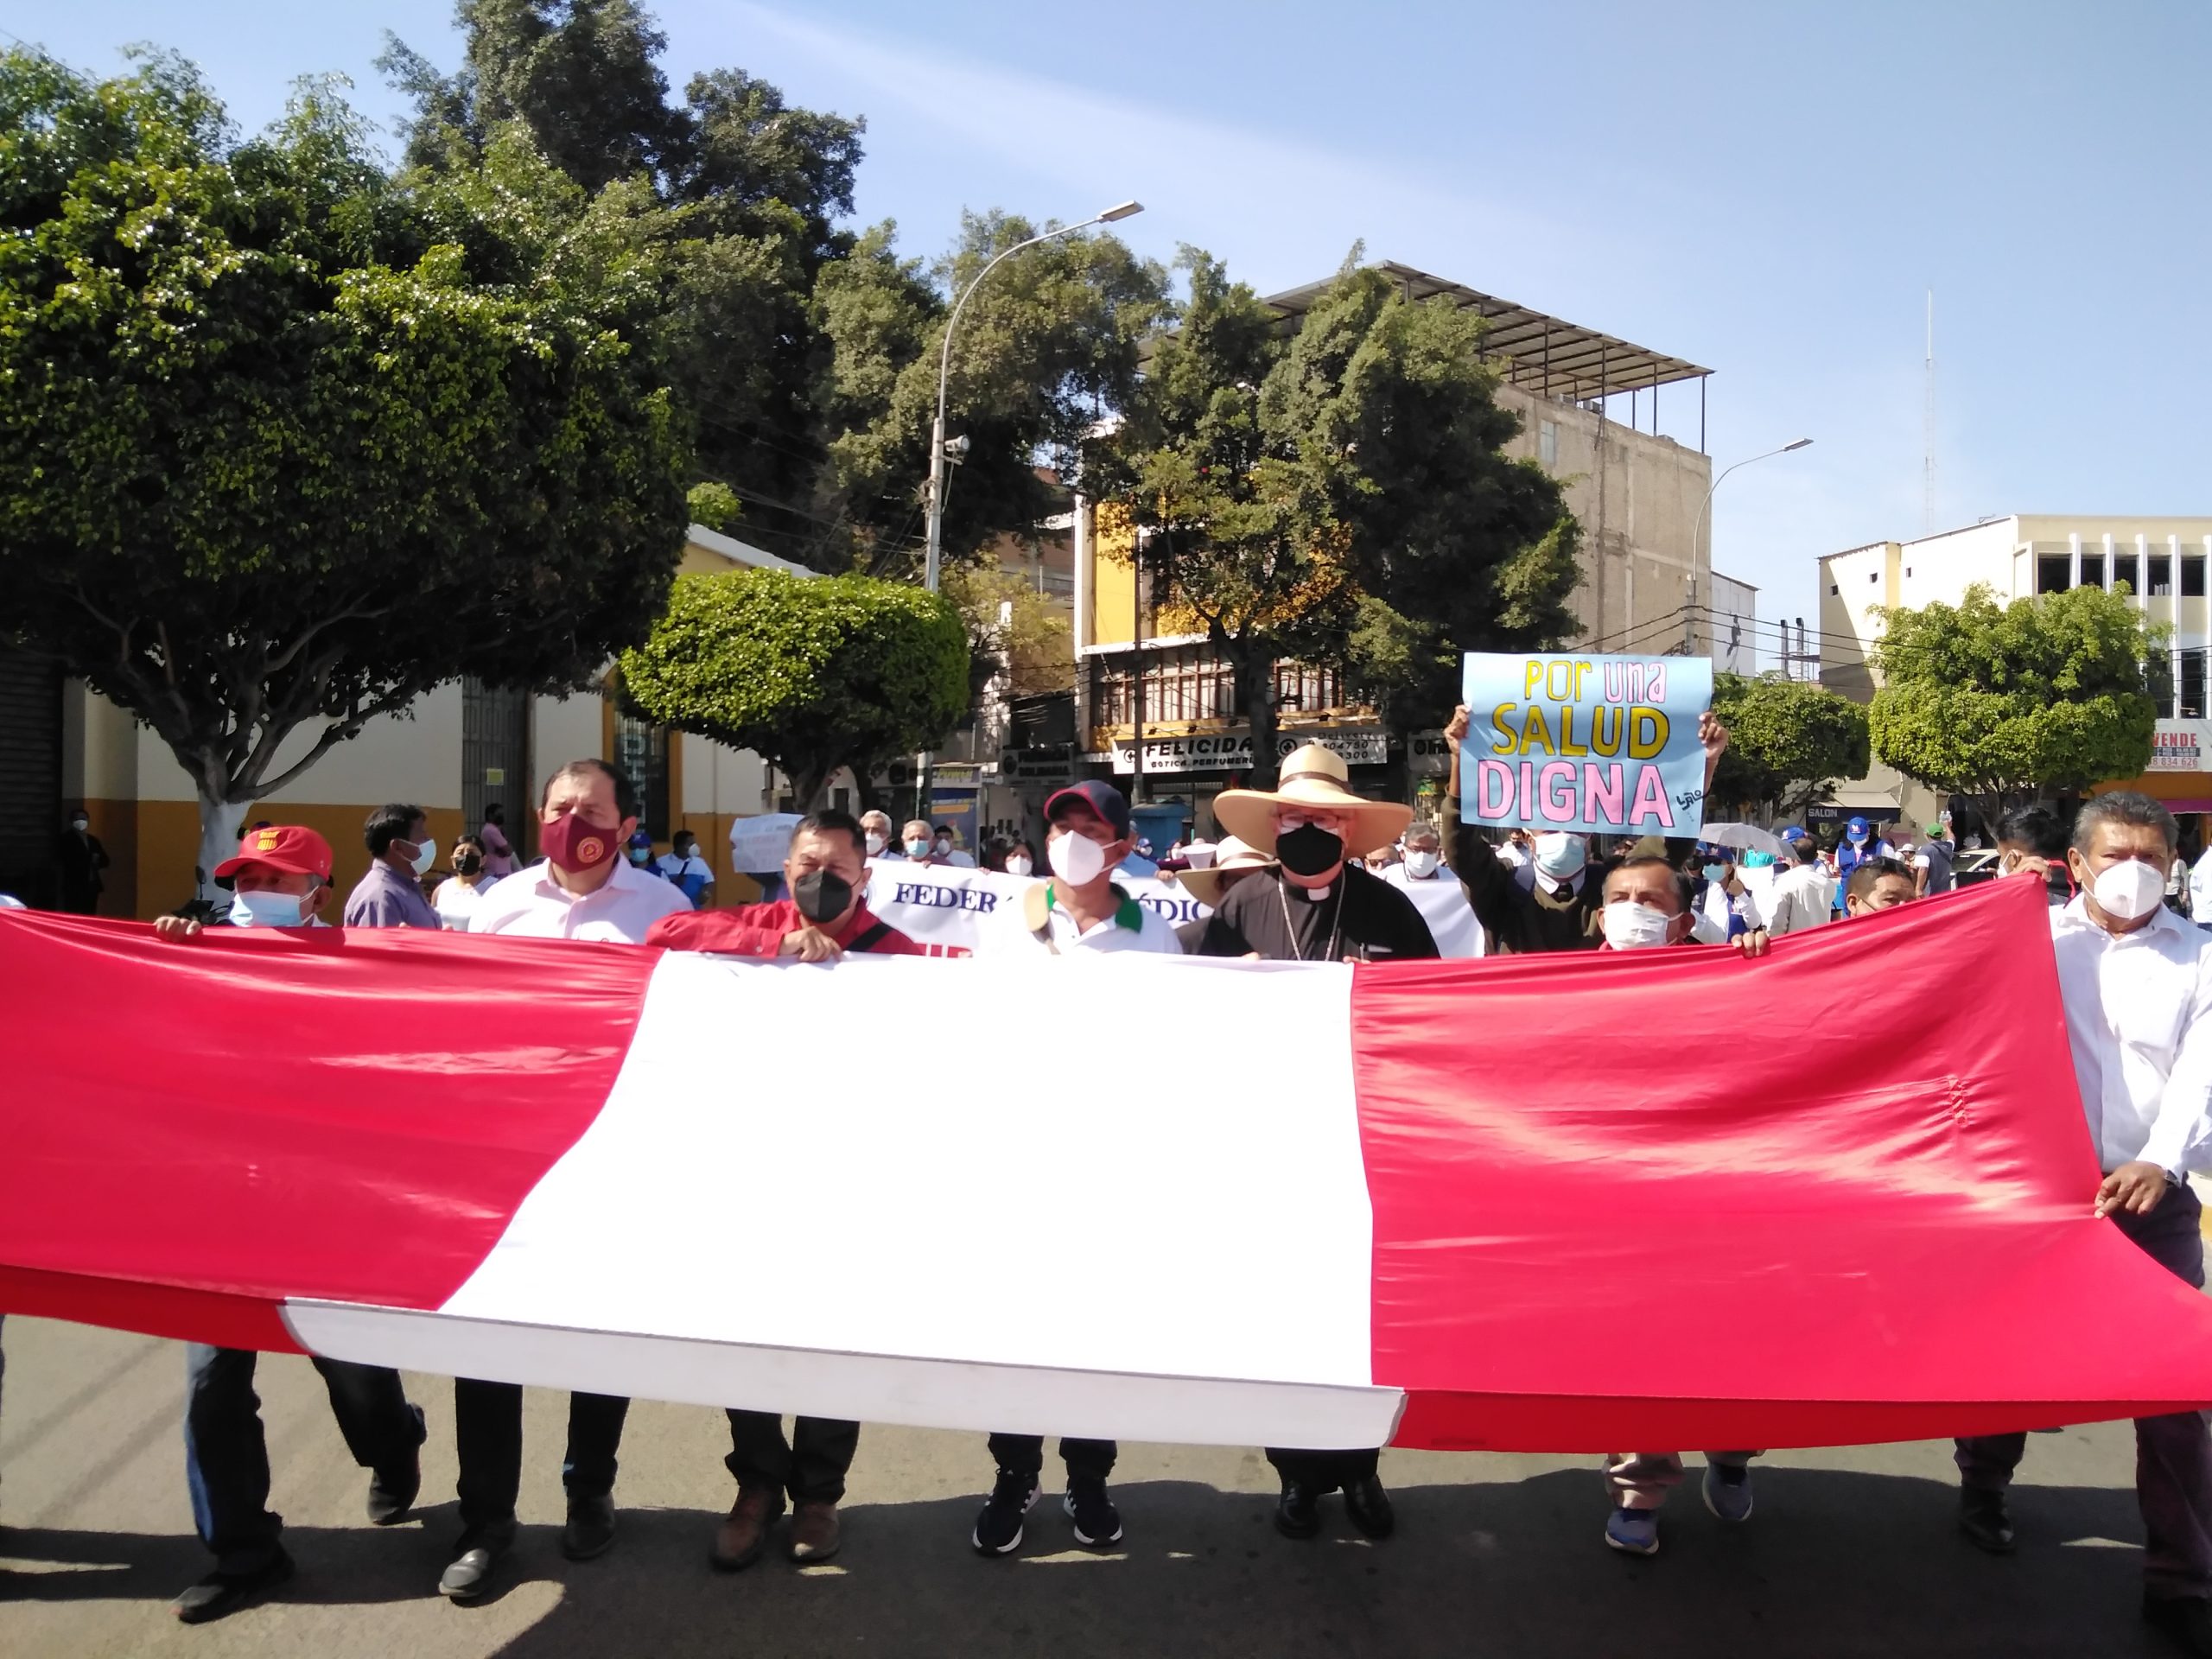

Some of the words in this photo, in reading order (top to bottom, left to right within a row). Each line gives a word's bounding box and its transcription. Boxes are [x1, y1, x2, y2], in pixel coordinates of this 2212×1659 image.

[1604, 661, 1666, 703] una
[1492, 702, 1670, 760] SALUD
[2152, 733, 2197, 747] VENDE
[1477, 760, 1675, 828] DIGNA
[1808, 808, 1838, 817] SALON
[893, 882, 999, 913] FEDER
